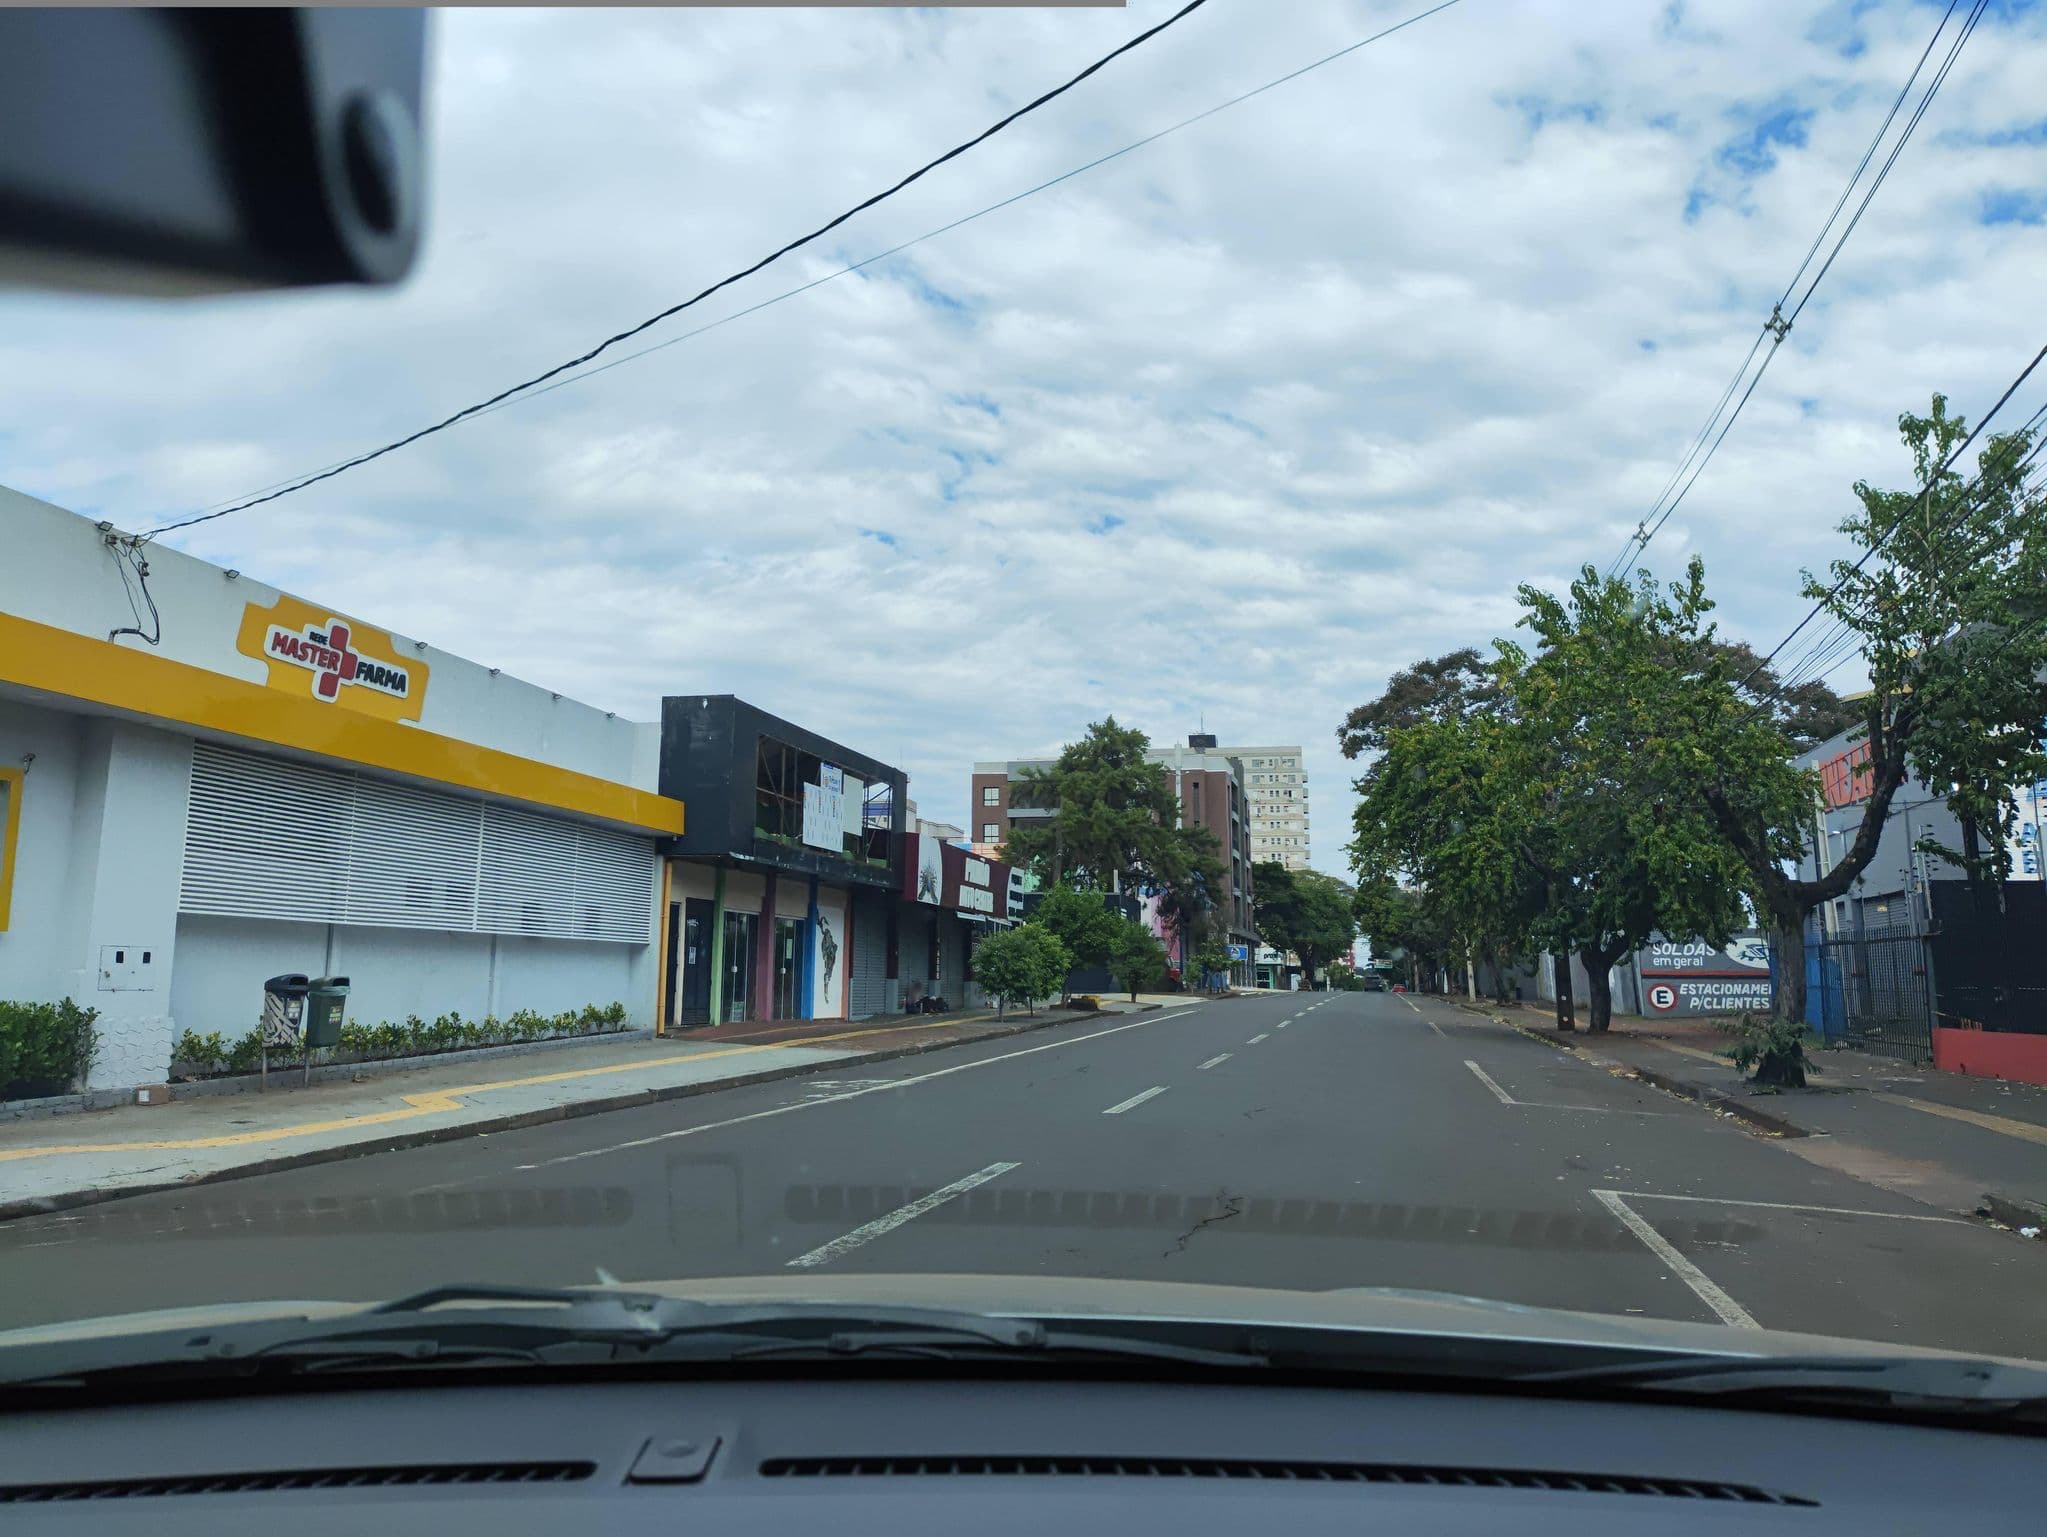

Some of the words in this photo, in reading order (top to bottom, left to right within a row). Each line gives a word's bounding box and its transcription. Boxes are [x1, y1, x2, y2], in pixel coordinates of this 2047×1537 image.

[309, 631, 328, 645] REDE
[271, 631, 341, 672] MASTER
[355, 661, 407, 693] FARMA
[1652, 943, 1716, 956] SOLDAS
[1653, 957, 1671, 966] em
[1673, 957, 1703, 970] geral
[1680, 983, 1772, 996] ESTACIONAME
[1656, 990, 1669, 1005] E
[1690, 996, 1770, 1011] P/CLIENTES
